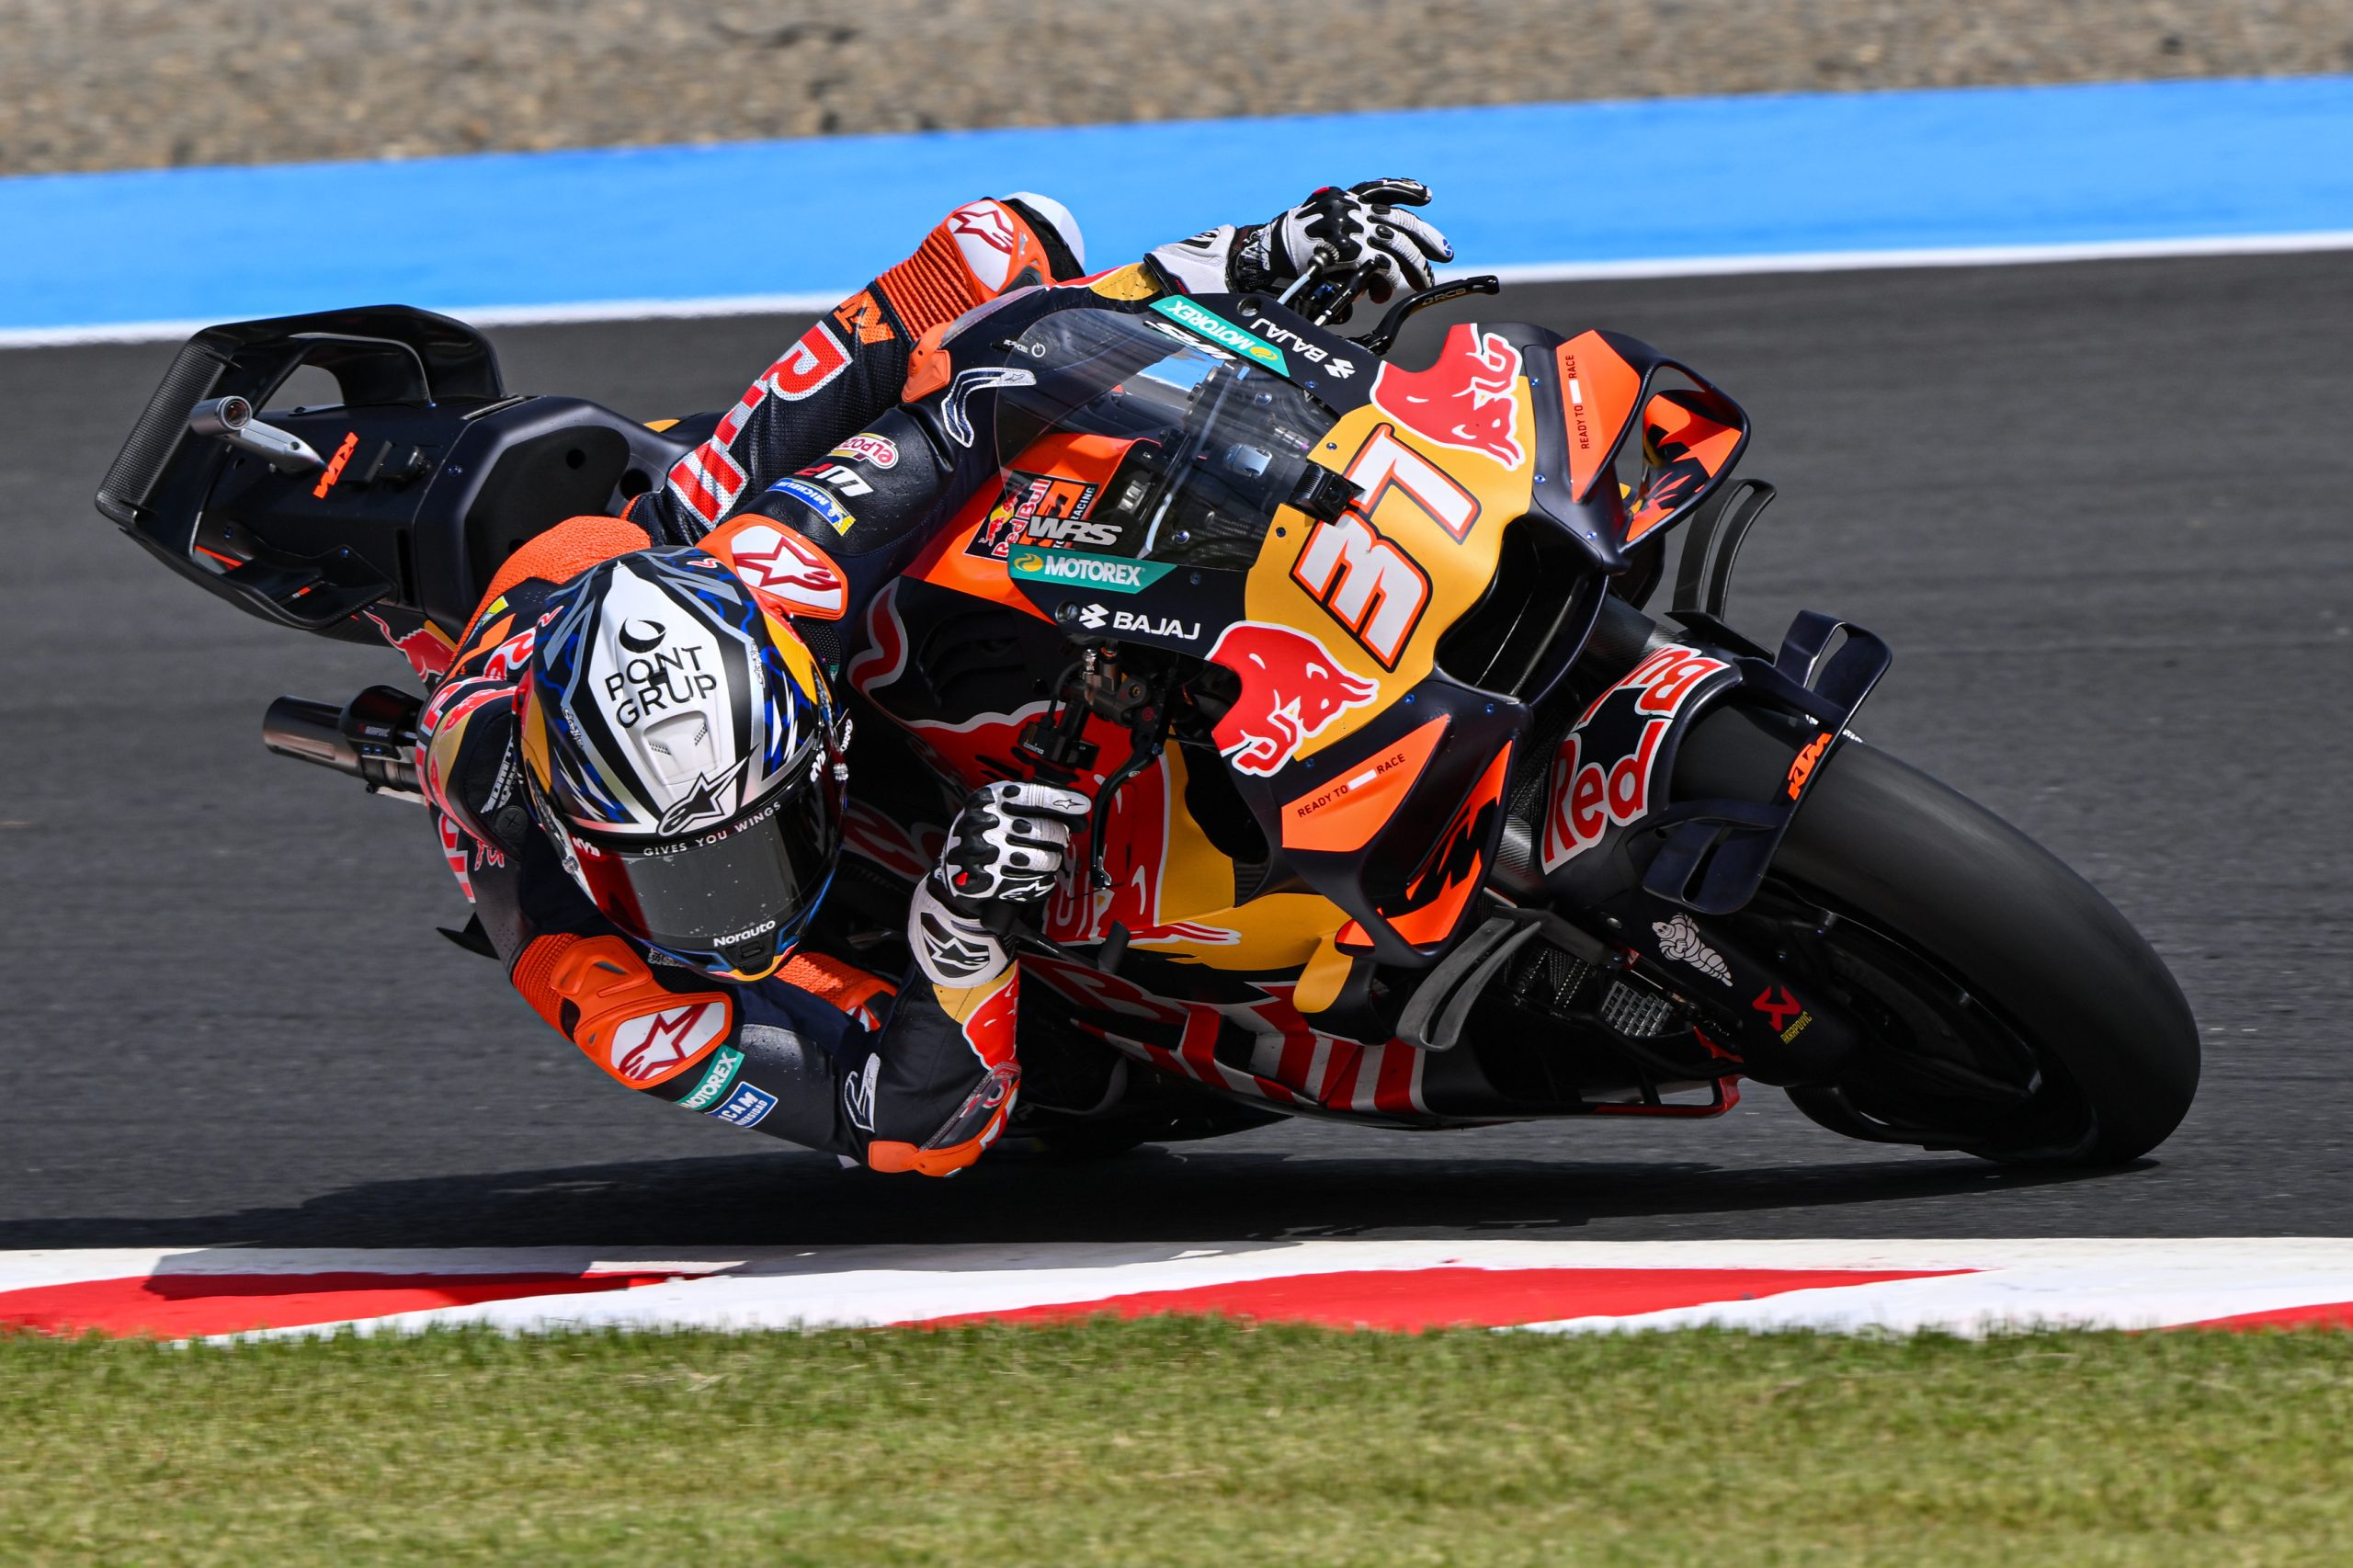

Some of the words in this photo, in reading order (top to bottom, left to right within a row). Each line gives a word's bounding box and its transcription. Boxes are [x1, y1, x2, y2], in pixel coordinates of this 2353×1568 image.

[1167, 301, 1256, 350] MOTOREX
[1249, 318, 1329, 363] BAJAJ
[1565, 355, 1577, 379] RACE
[1574, 404, 1584, 417] TO
[1577, 419, 1590, 449] READY
[313, 431, 358, 499] KTM
[991, 517, 1029, 558] Red
[1015, 478, 1051, 519] Bull
[1028, 516, 1123, 546] WRS
[1044, 555, 1141, 586] MOTOREX
[1289, 422, 1482, 674] 37
[1113, 610, 1201, 641] BAJAJ
[605, 645, 702, 701] PONT
[616, 674, 717, 729] GRUP
[1297, 793, 1332, 818] READY
[1333, 785, 1349, 798] TO
[1376, 753, 1406, 775] RACE
[1788, 733, 1833, 801] KTM
[1542, 719, 1673, 874] Red
[643, 843, 688, 857] GIVES
[695, 830, 728, 847] YOU
[733, 801, 781, 833] WINGS
[713, 920, 776, 947] Norauto
[685, 1051, 737, 1109] MOTOREX
